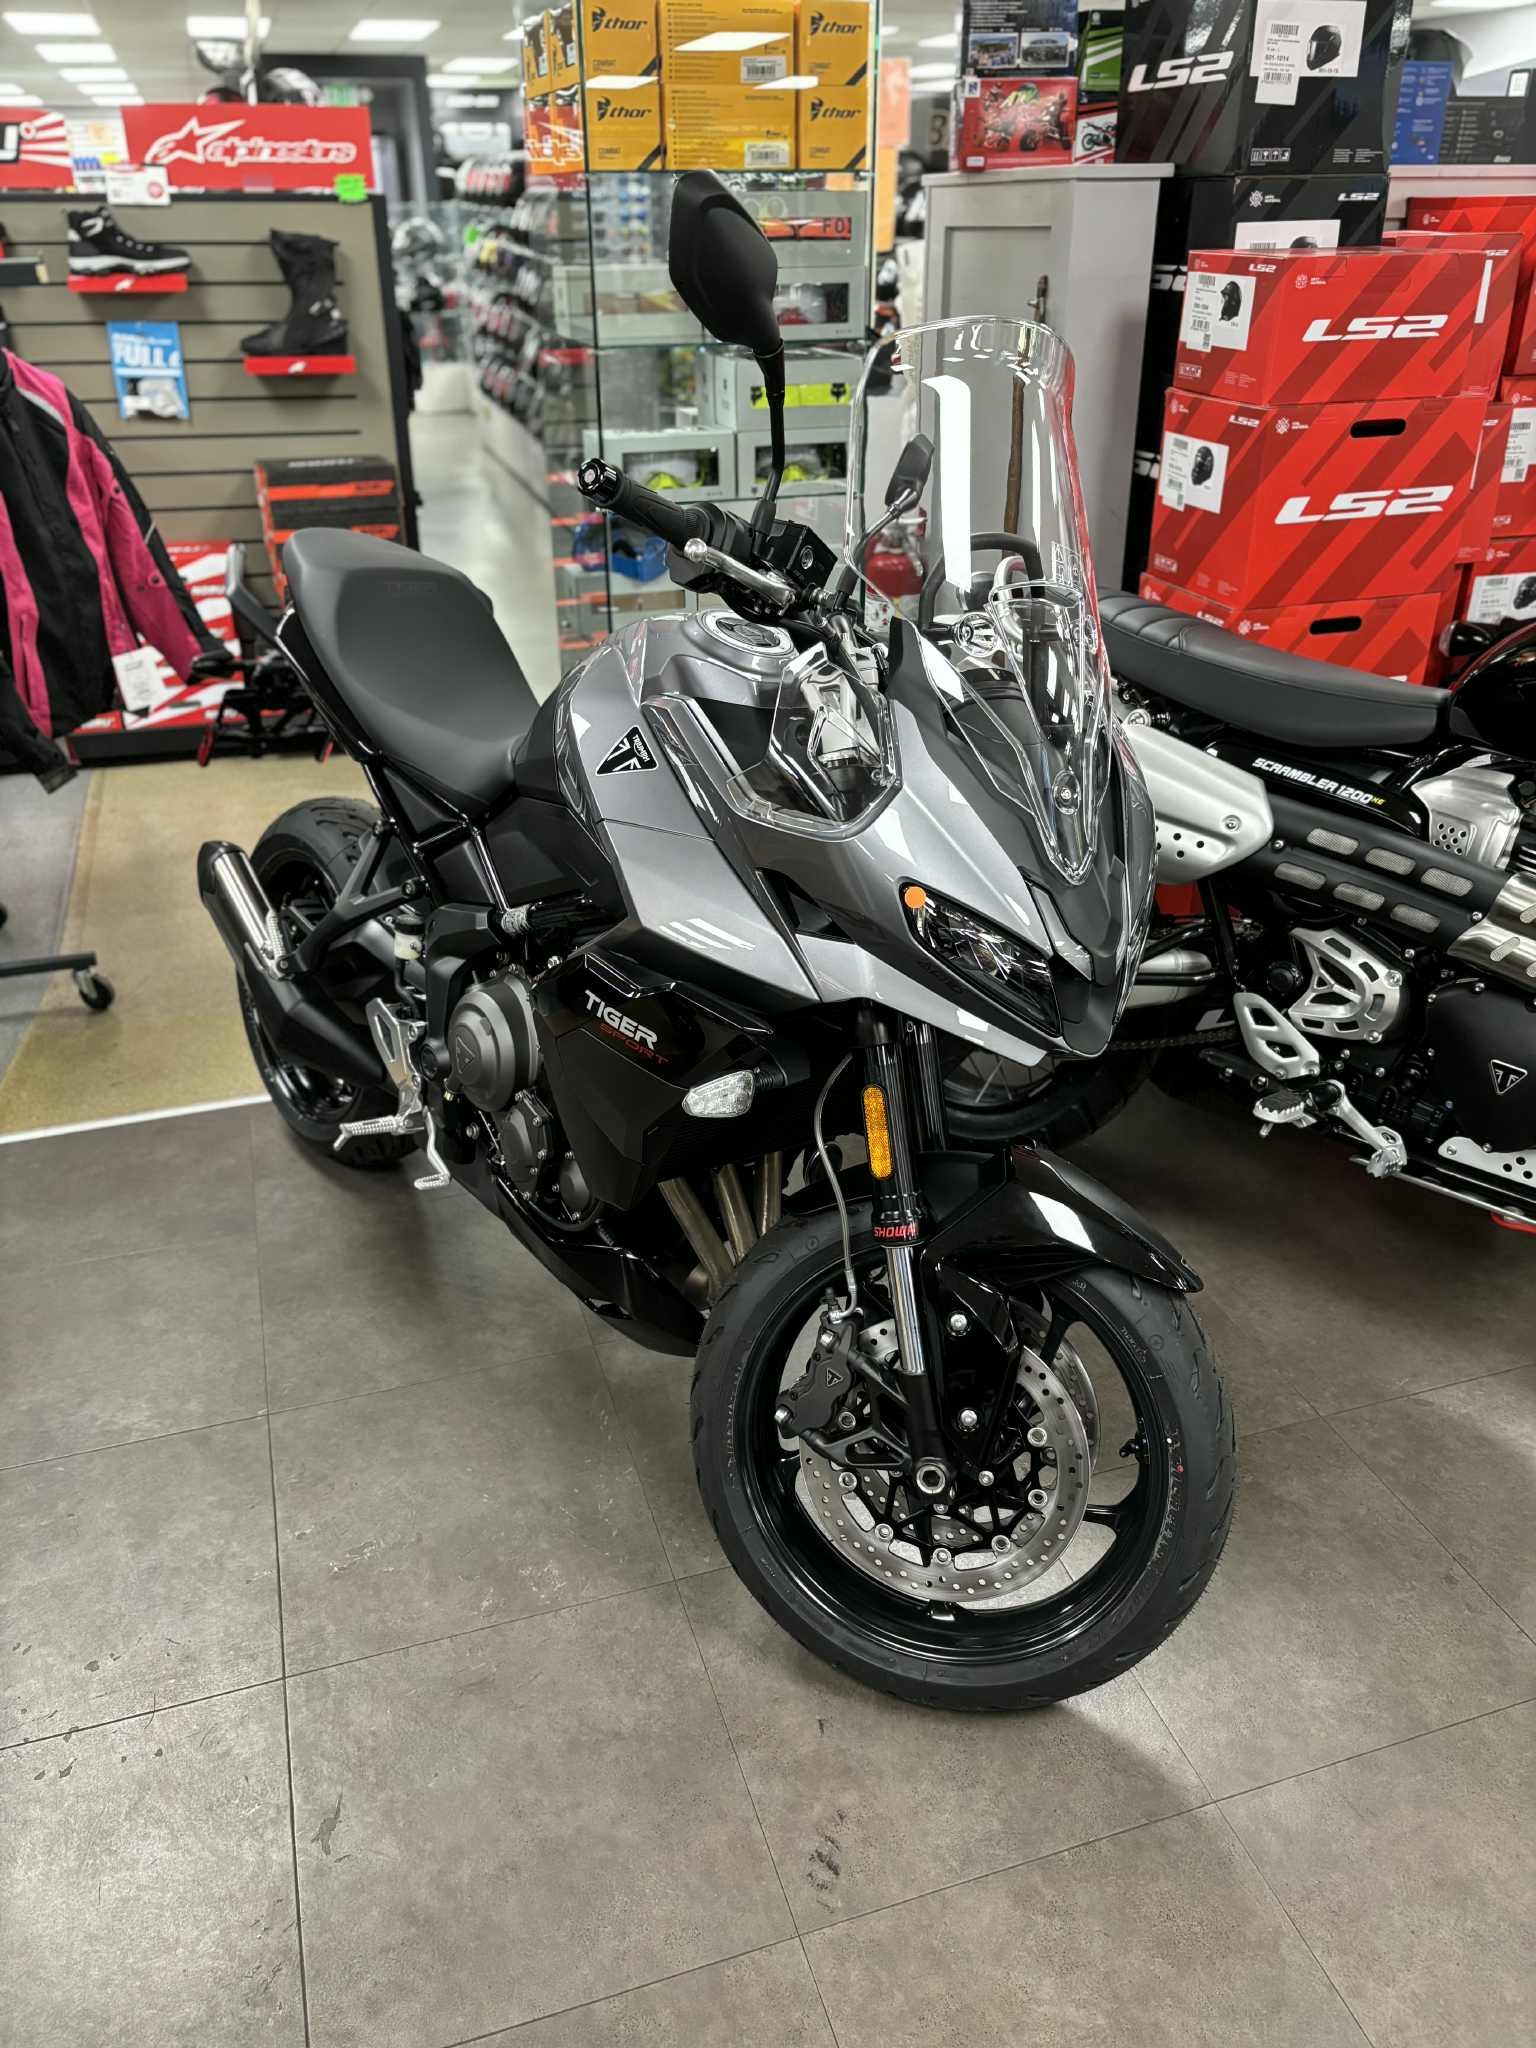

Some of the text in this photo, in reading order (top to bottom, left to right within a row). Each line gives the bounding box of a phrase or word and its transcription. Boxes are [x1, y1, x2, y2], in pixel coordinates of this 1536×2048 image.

[604, 17, 648, 30] thor
[822, 21, 863, 33] thor
[1127, 50, 1234, 93] LS2
[609, 106, 652, 118] thor
[822, 106, 862, 119] thor
[1337, 192, 1380, 202] LS2
[1248, 263, 1277, 273] LS2
[1302, 314, 1448, 342] LS2
[1228, 415, 1260, 428] LS2
[1274, 485, 1454, 525] LS2
[632, 734, 650, 762] TRIUMPH
[1251, 757, 1338, 793] SCRAMBLER
[584, 989, 658, 1050] TIGER
[599, 1022, 670, 1065] SPORT
